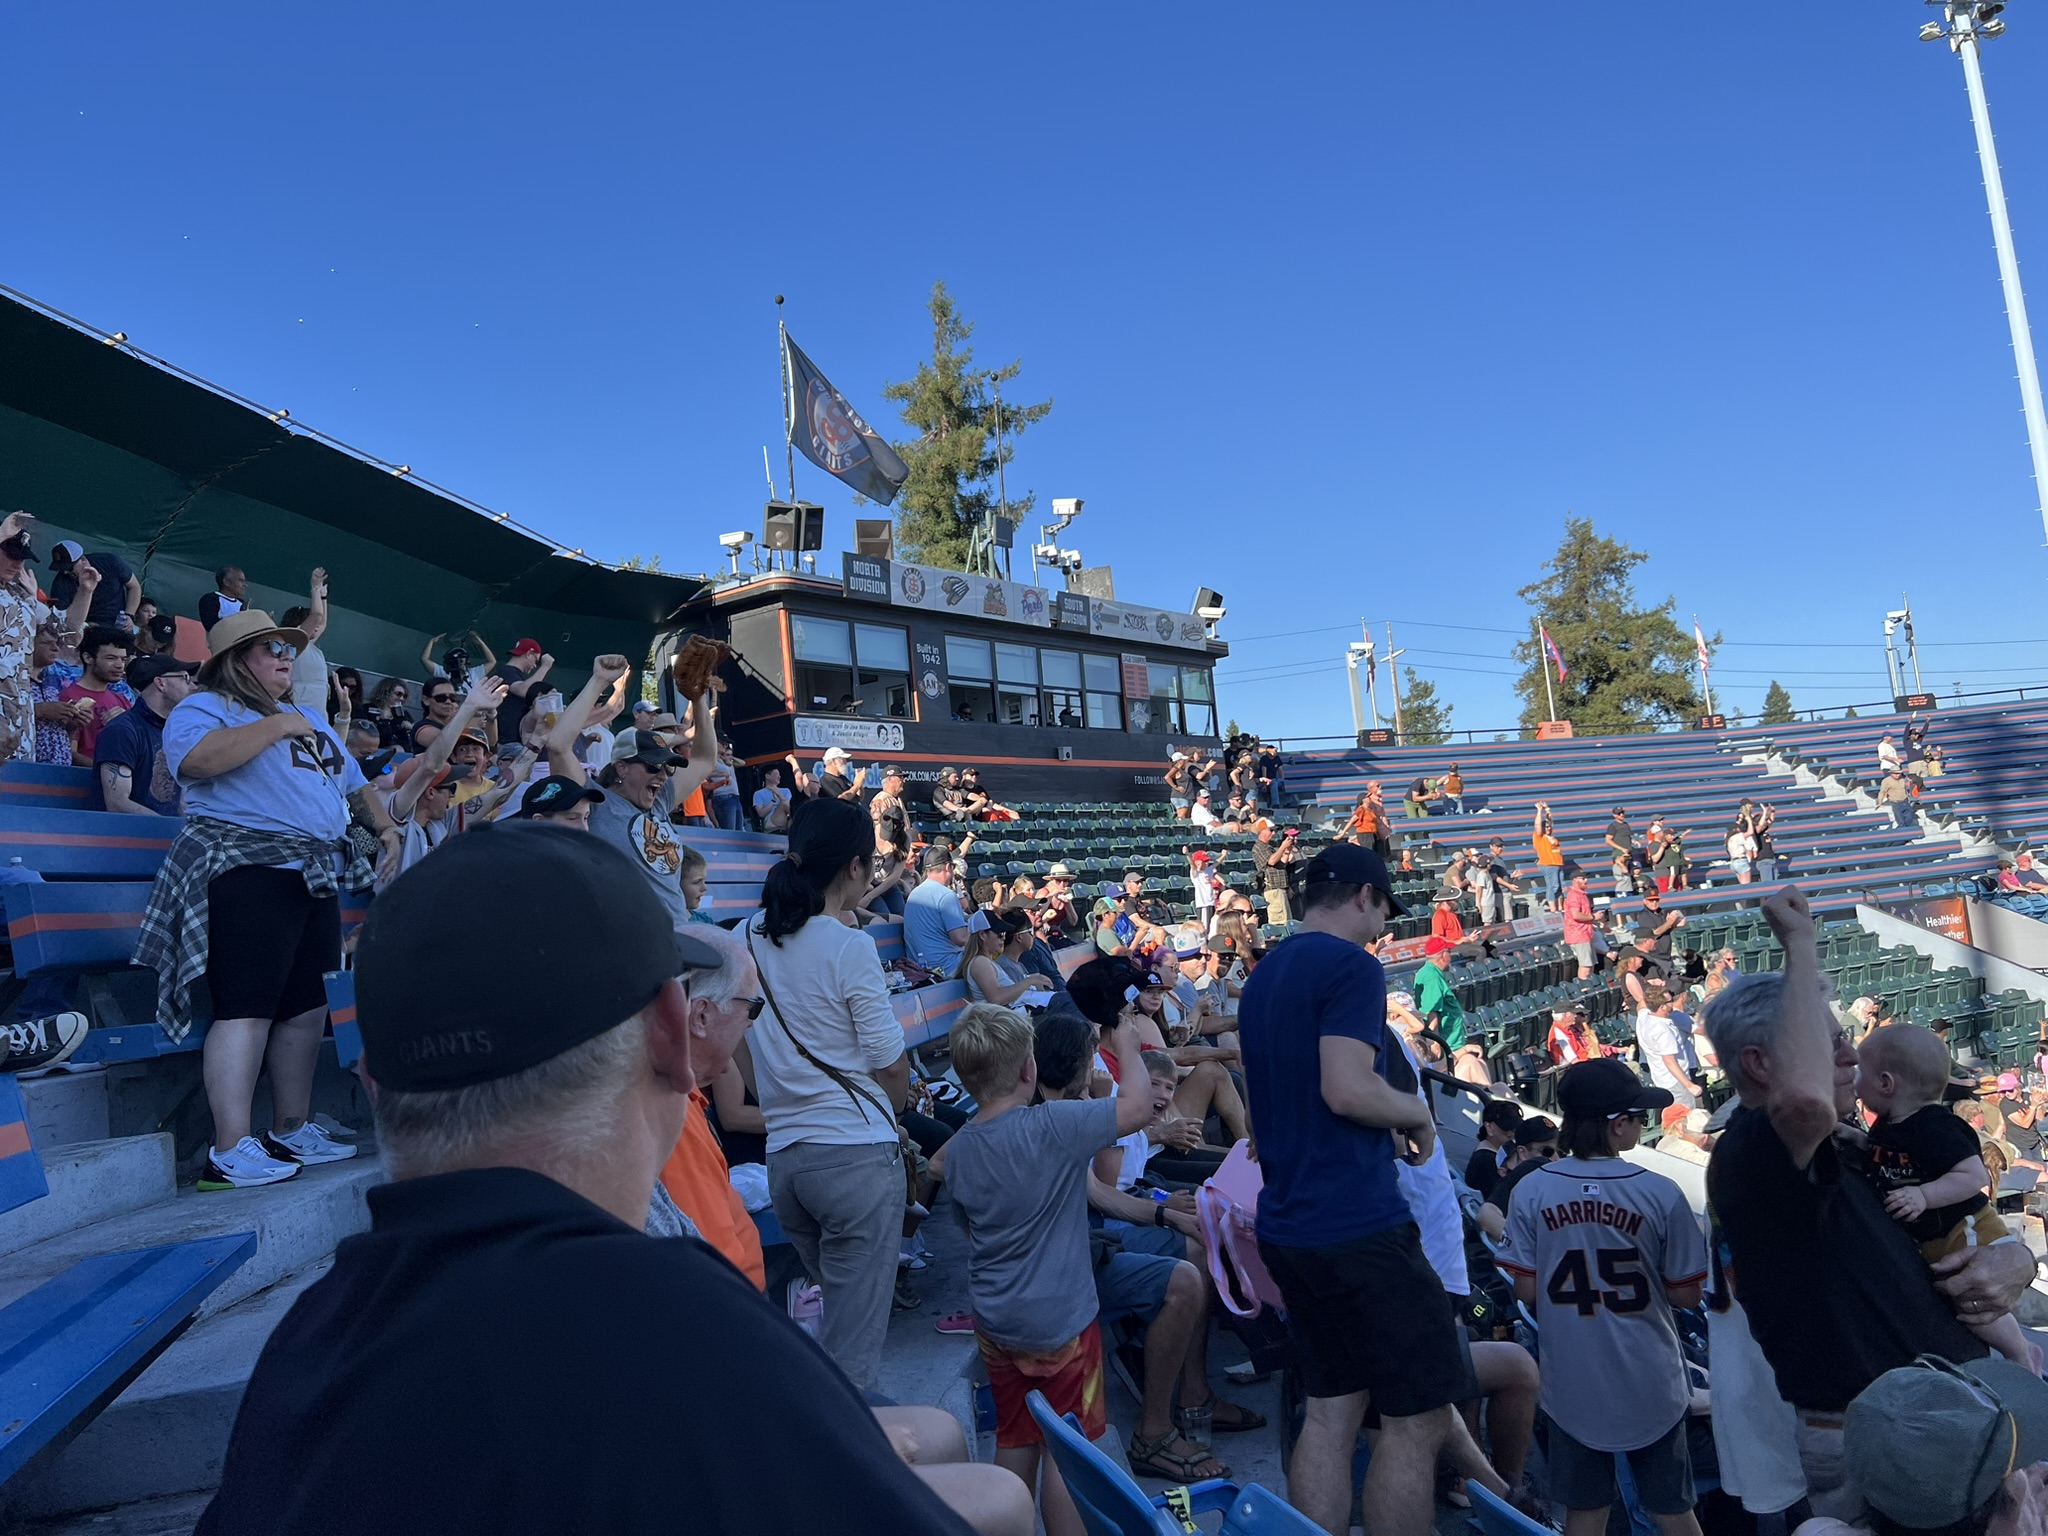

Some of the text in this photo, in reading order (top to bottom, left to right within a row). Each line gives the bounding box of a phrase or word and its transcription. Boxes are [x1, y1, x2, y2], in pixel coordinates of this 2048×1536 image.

[852, 560, 881, 578] NORTH
[849, 576, 887, 596] DIVISION
[916, 643, 940, 654] Built in
[921, 653, 941, 665] 1942
[1925, 913, 1962, 928] Healthier
[1540, 1200, 1645, 1237] HARRISON
[1547, 1247, 1652, 1317] 45
